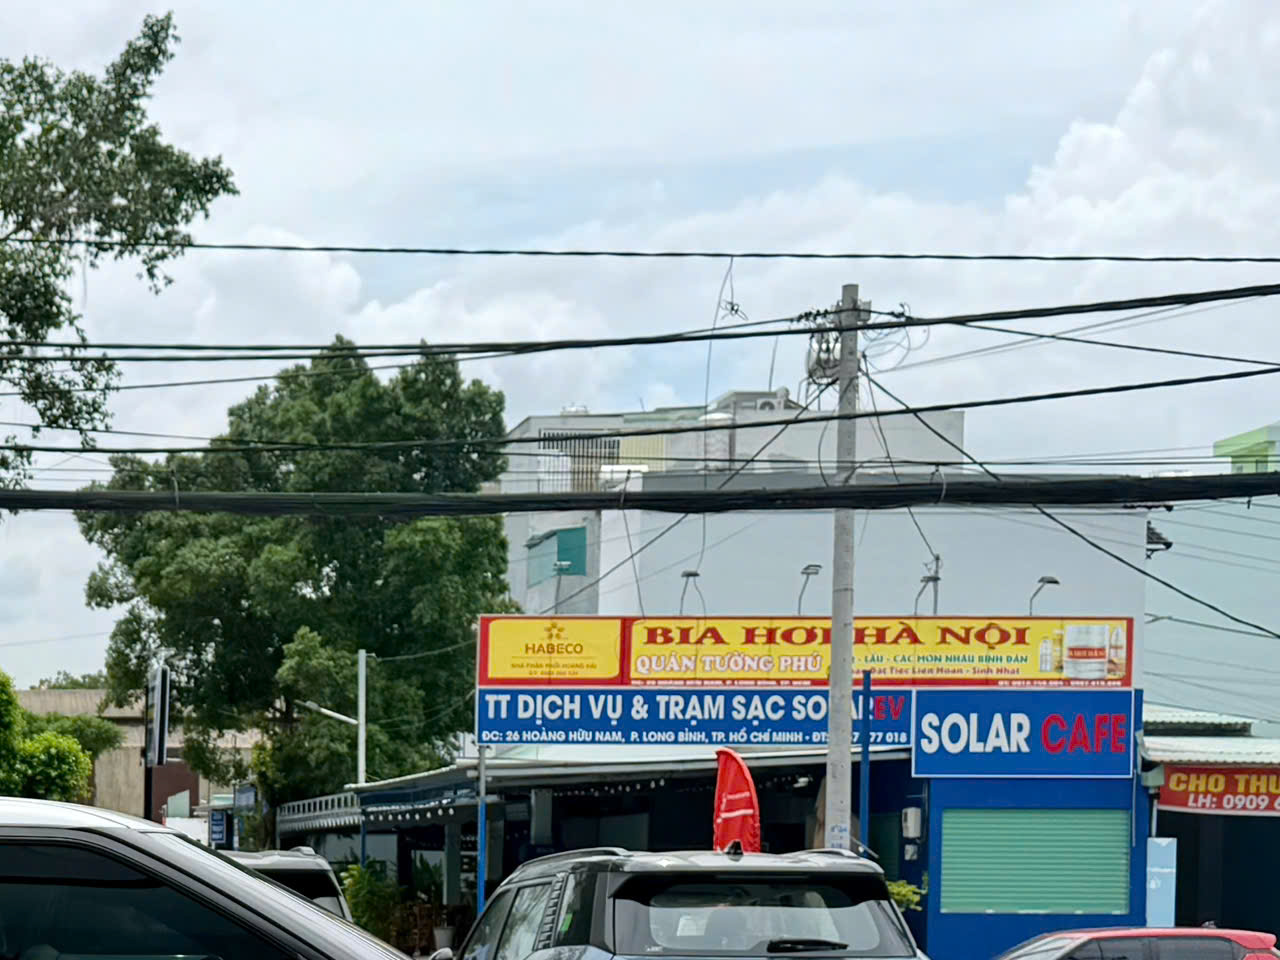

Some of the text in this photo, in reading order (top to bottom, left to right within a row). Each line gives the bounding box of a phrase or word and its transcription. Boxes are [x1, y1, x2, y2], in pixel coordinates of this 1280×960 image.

[643, 626, 729, 646] BIA
[936, 622, 1031, 650] NỘI
[524, 642, 584, 655] HABECO
[636, 651, 697, 674] QUÁN
[485, 694, 511, 719] TT
[517, 694, 580, 726] DỊCH
[587, 694, 623, 726] VỤ
[631, 695, 648, 720] &
[656, 695, 725, 726] TRẠM
[731, 695, 786, 726] SẠC
[482, 731, 503, 741] ĐC:
[506, 731, 520, 741] 26
[522, 726, 566, 741] HOÀNG
[569, 728, 593, 741] HỮU
[595, 731, 626, 743] NAM,
[631, 731, 640, 742] P.
[643, 731, 675, 742] LONG
[678, 727, 709, 743] BÌNH,
[712, 731, 726, 742] TP.
[729, 727, 747, 742] HỒ
[750, 728, 771, 742] CHÍ
[773, 731, 803, 742] MINH
[920, 712, 1127, 754] SOLAR CAFE
[1168, 773, 1226, 793] CHO
[1188, 794, 1218, 808] LH:
[1222, 794, 1270, 810] 0909
